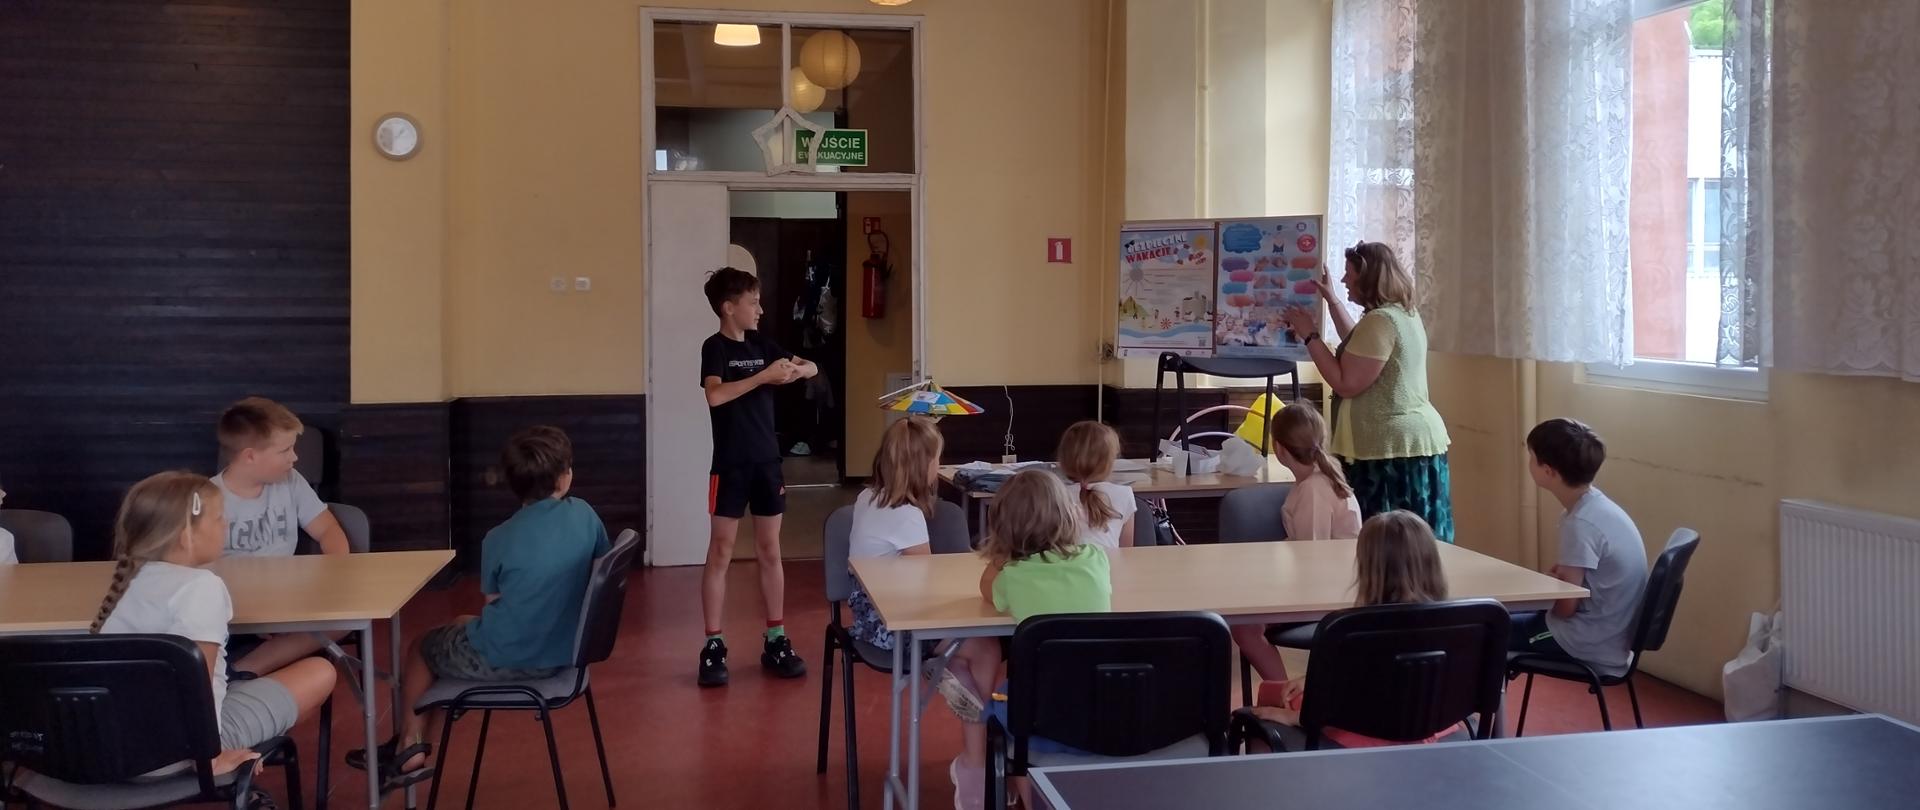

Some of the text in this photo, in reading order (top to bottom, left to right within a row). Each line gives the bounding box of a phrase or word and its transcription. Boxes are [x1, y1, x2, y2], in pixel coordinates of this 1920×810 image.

[801, 135, 861, 149] WJŚCIE
[798, 152, 864, 160] EWKUACYJNE
[1125, 246, 1172, 264] WAKACJE
